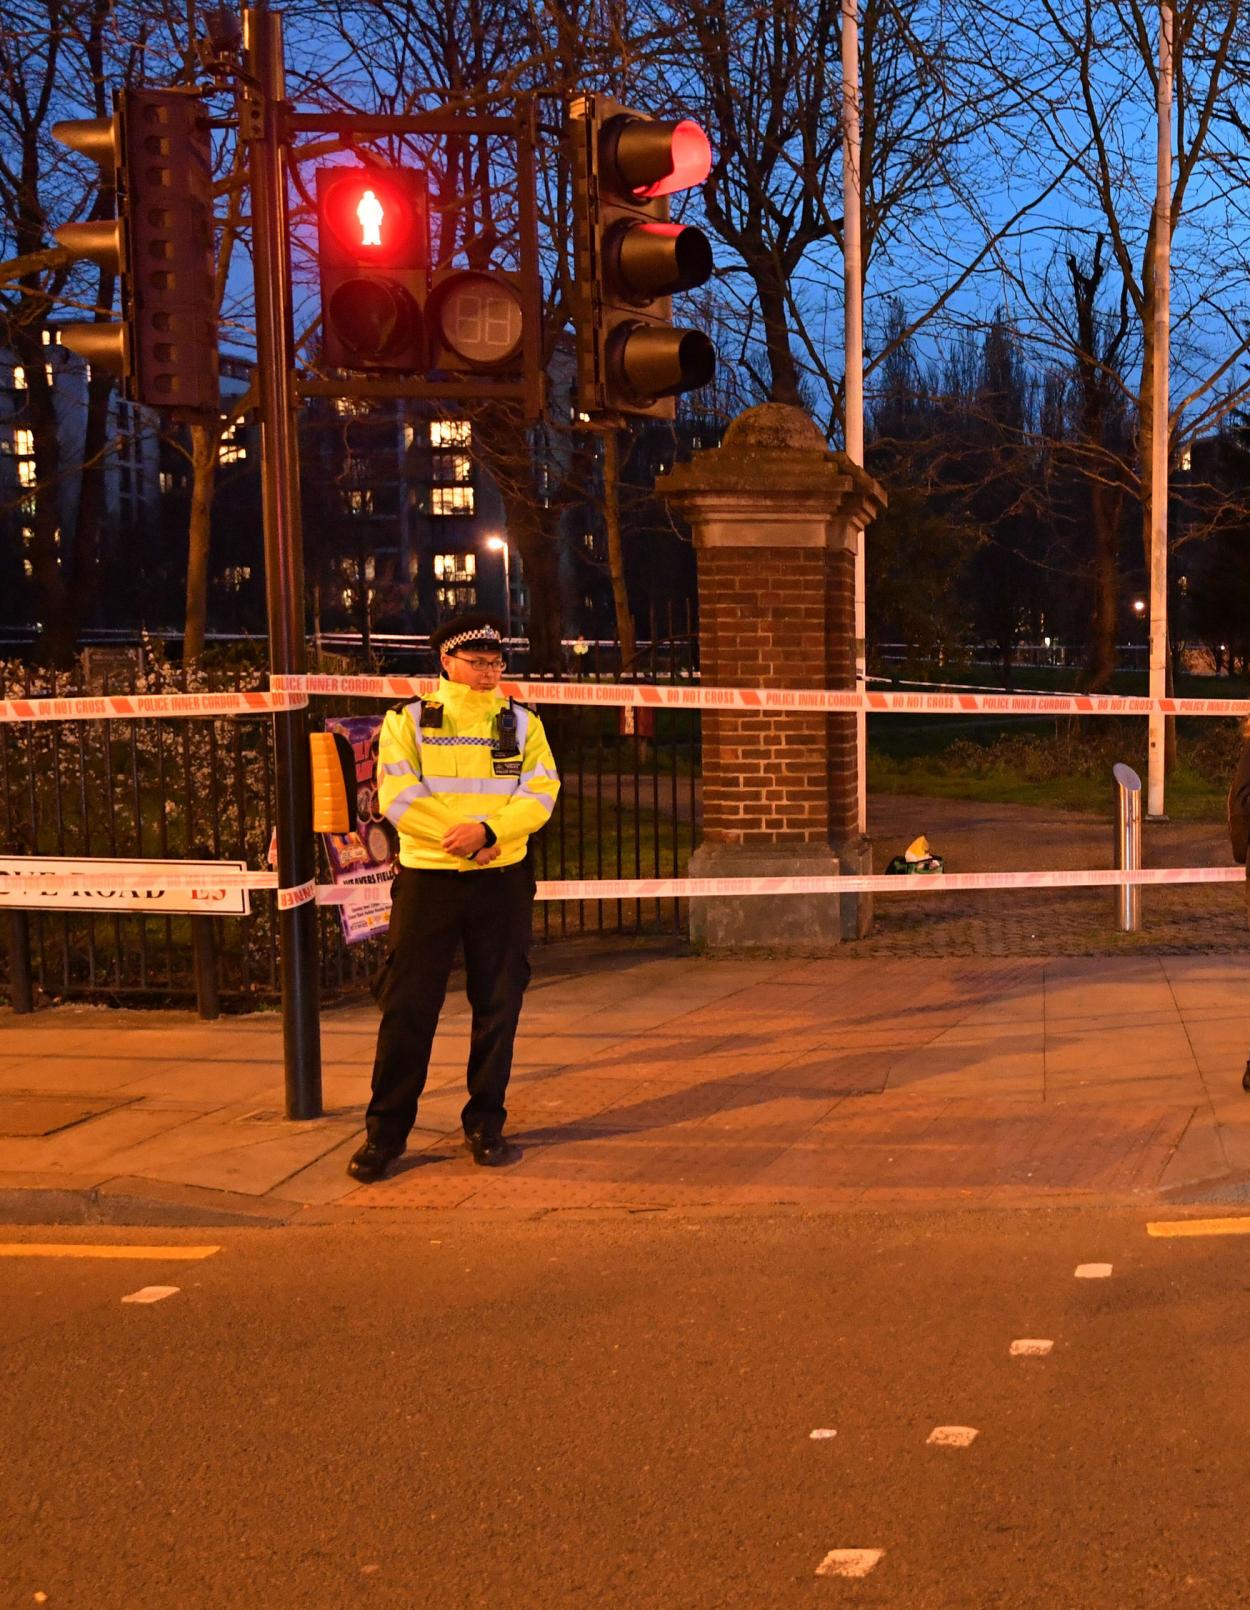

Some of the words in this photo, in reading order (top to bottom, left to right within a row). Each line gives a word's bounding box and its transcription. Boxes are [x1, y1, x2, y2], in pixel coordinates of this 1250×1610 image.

[306, 677, 338, 691] INNER
[341, 678, 383, 693] CORDON
[419, 679, 433, 694] DO
[528, 684, 560, 699] POLICE
[562, 686, 593, 700] INNER
[595, 687, 634, 701] CORDON
[138, 697, 169, 712] POLICE
[171, 696, 200, 711] INNER
[202, 694, 240, 710] CORDON
[272, 692, 285, 706] DO
[667, 689, 680, 704] DO
[682, 689, 701, 704] NOT
[704, 690, 734, 705] CROSS
[766, 691, 796, 706] POLICE
[798, 692, 826, 706] INNER
[828, 693, 863, 707] CORDON
[892, 695, 904, 708] DO
[906, 695, 924, 709] NOT
[926, 696, 954, 709] CROSS
[982, 697, 1010, 710] POLICE
[1012, 697, 1036, 710] INNER
[1038, 698, 1071, 711] CORDON
[1098, 698, 1109, 711] DO
[1111, 698, 1126, 711] NOT
[1128, 699, 1153, 711] CROSS
[38, 701, 51, 716] DO
[54, 700, 72, 715] NOT
[76, 699, 106, 714] CROSS
[1179, 700, 1203, 712] POLICE
[1205, 700, 1230, 712] INNER
